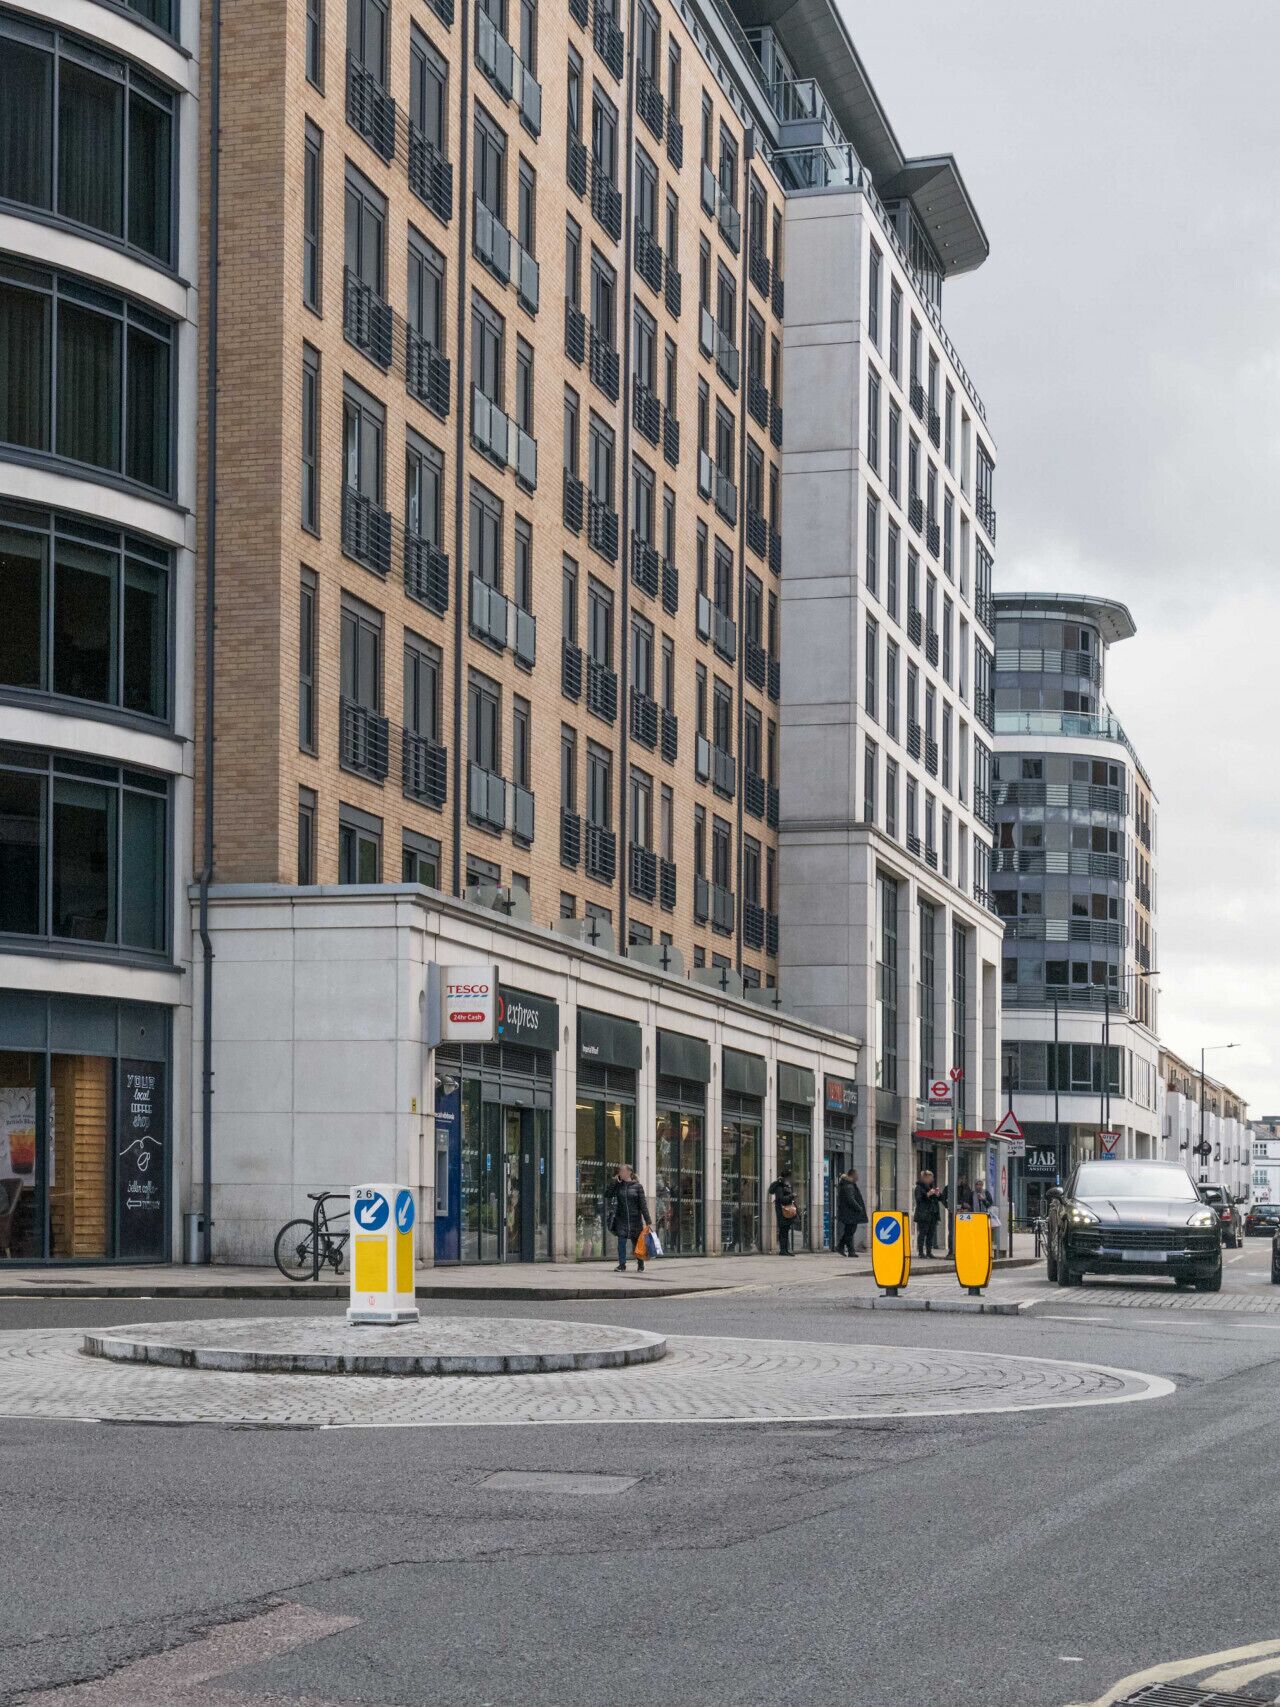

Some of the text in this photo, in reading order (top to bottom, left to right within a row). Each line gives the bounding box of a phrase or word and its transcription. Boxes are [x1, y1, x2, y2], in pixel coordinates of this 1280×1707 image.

[447, 985, 489, 994] TESCO
[507, 1003, 539, 1033] express
[952, 1069, 960, 1078] Y
[127, 1075, 155, 1089] YOUR
[133, 1088, 150, 1101] local
[131, 1103, 152, 1114] COFFEE
[1029, 1151, 1056, 1166] JAB
